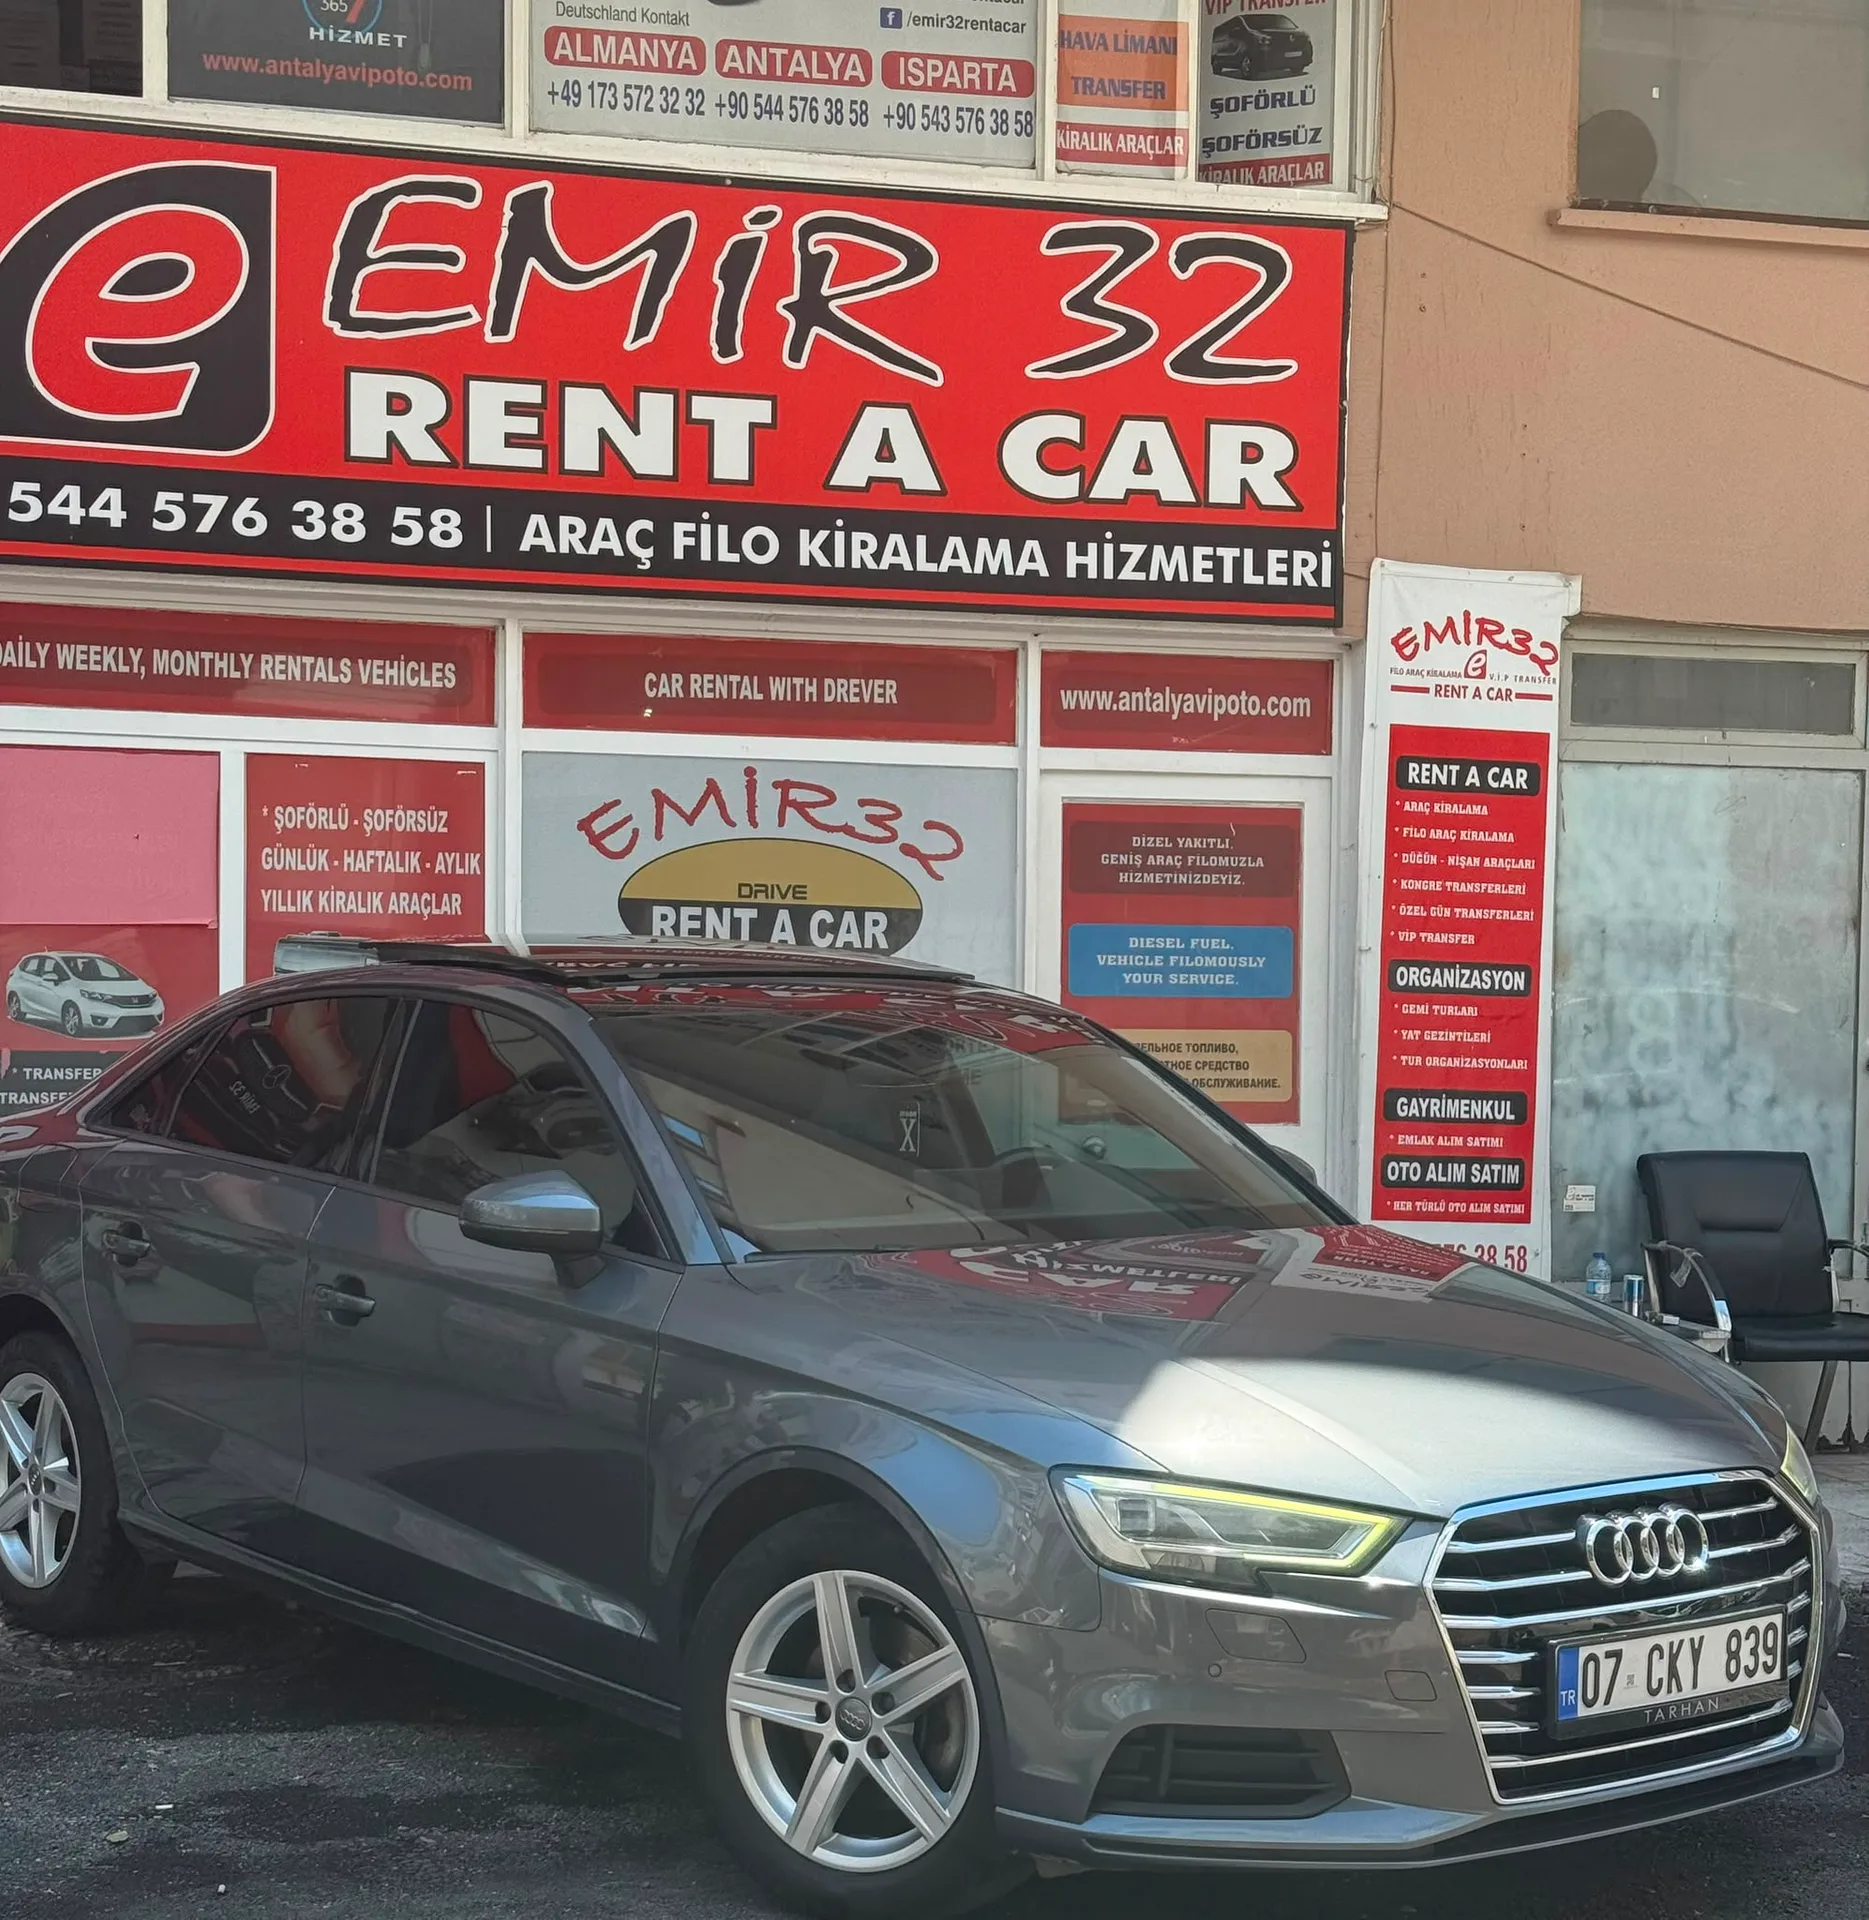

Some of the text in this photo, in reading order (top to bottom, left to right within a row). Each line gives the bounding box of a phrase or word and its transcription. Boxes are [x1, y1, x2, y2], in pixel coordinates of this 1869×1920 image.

[555, 1, 690, 27] Deutschland Kontakt
[907, 12, 1026, 34] /emir32rentacar
[309, 24, 407, 48] HİZMET
[1060, 30, 1109, 52] HAVA
[553, 32, 698, 70] ALMANYA
[722, 44, 866, 82] ANTALYA
[202, 53, 473, 91] www.antalyavipoto.com
[899, 57, 1017, 92] ISPARTA
[548, 79, 706, 116] +49 173 572 32 32
[1071, 76, 1166, 100] TRANSFER
[715, 91, 869, 127] +90 544 576 38 58
[1210, 85, 1316, 119] ŞOFÖRLÜ
[883, 102, 1034, 137] +90 543 576 38 58
[1056, 124, 1184, 160] KİRALIK ARAÇLAR
[1202, 125, 1323, 158] ŞOFÖRSÜZ
[1257, 161, 1325, 186] ARAÇLAR
[322, 174, 1298, 388] EMİR 32
[344, 365, 1304, 512] RENT A CAR
[7, 481, 1332, 588] 544 576 38 58 ARAÇ FİLO KİRALAMA HİZMETLERİ
[0, 634, 457, 688] AİLY WEEKLY, MONTHLY RENTALS VEHİCLES
[1405, 668, 1425, 679] ARAÇ
[1426, 667, 1462, 679] KİRALAMA
[644, 672, 898, 704] CAR RENTAL WITH DREVER
[1514, 674, 1557, 685] TRANSFER
[1060, 686, 1311, 721] www.antalyavipoto.com
[1434, 684, 1513, 702] RENT A CAR
[1408, 762, 1528, 789] RENT A CAR
[274, 802, 448, 836] ŞOFÖRLÜ ŞOFÖRSÜZ
[1403, 801, 1488, 815] ARAÇ KİRALAMA
[576, 765, 964, 881] EMİR32
[1403, 826, 1515, 843] FİLO ARAÇ KİRALAMA
[1132, 834, 1173, 848] DİZEL
[261, 843, 481, 875] GÜNLÜK HAFTALIK AYLIK
[1101, 851, 1265, 869] GENİŞ ARAÇ FİLOMUZLA
[1402, 851, 1535, 871] DÜĞÜN NİŞAN ARAÇLARI
[1119, 869, 1245, 885] HİZMETİNİZDEYİZ.
[1401, 879, 1526, 895] KONGRE TRANSFERLERİ
[260, 885, 462, 921] YILLIK KİRALIK ARAÇLAR
[737, 883, 808, 900] DRIVE
[1399, 903, 1534, 921] ÖZEL GÜN TRANSFERLERİ
[652, 905, 889, 949] RENT A CAR
[1398, 929, 1475, 944] VİP TRANSFER
[1129, 937, 1185, 949] DIESEL
[1097, 954, 1266, 968] VEHICLE FILOMOUSLY
[1123, 973, 1239, 985] YOUR SERVICE.
[1396, 963, 1525, 991] ORGANİZASYON
[1402, 1002, 1478, 1016] GEMİ TURLARI
[1401, 1029, 1490, 1043] YAT GEZİNTİLERİ
[1195, 1060, 1249, 1072] СРЕДСТВО
[1400, 1055, 1528, 1070] TUR ORGANİZASYONLARI
[0, 1092, 73, 1104] TRANSFE
[1396, 1094, 1515, 1120] GAYRİMENKUL
[1397, 1134, 1503, 1147] EMLAK ALIM SATIMI
[1387, 1161, 1520, 1184] OTO ALIM SATIM
[1393, 1199, 1525, 1214] HER TÜRLÜ OTO ALIM SATIMI
[1504, 1245, 1527, 1273] 58
[1581, 1621, 1779, 1708] 07 CKY 839
[1560, 1690, 1576, 1707] TR
[1644, 1697, 1719, 1723] TARHAN
